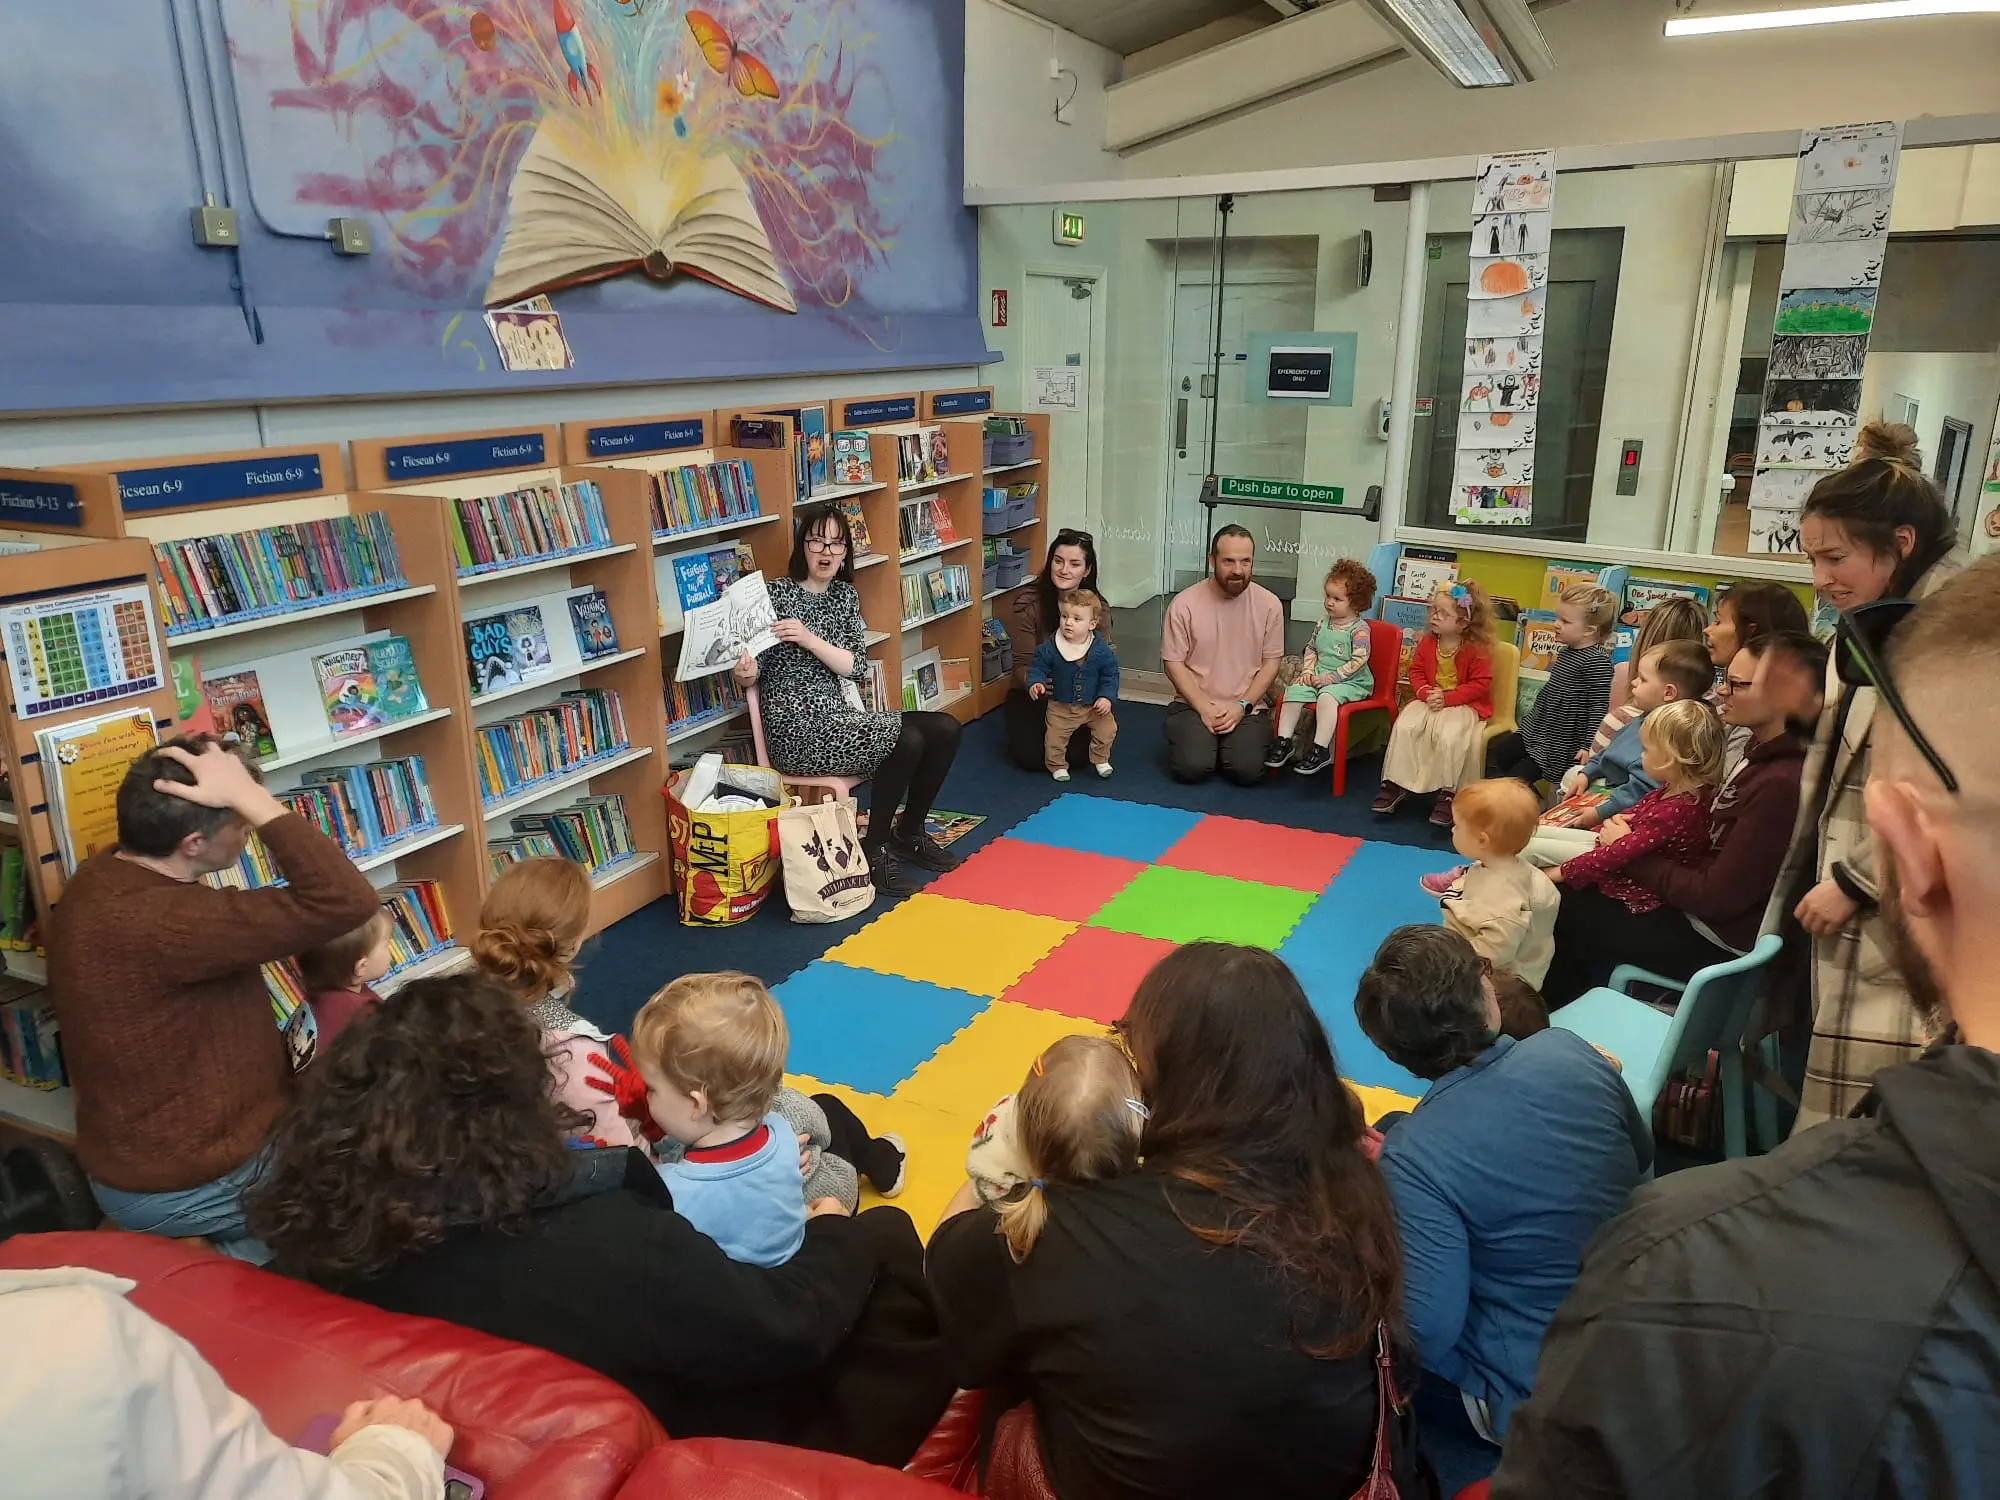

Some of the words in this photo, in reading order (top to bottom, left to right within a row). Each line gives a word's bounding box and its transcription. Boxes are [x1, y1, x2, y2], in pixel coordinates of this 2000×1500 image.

[1277, 368, 1309, 376] EMERGENCY
[600, 436, 623, 448] Ficsean
[623, 434, 635, 445] 6-9
[664, 429, 684, 440] Fiction
[684, 427, 695, 439] 6-9
[492, 444, 519, 458] Fiction
[519, 443, 533, 456] 6-9
[402, 453, 435, 468] Ficsean
[436, 451, 450, 464] 6-9
[246, 470, 283, 486] Fiction
[285, 467, 304, 482] 6-9
[162, 479, 183, 494] 6-9
[1229, 479, 1260, 494] Push
[1262, 483, 1283, 495] bar
[1286, 484, 1299, 496] to
[1302, 488, 1334, 501] open
[0, 492, 36, 509] Fiction
[36, 495, 60, 511] 9-13
[1631, 588, 1646, 598] One
[1647, 589, 1668, 602] Sweet
[473, 622, 506, 644] BAD
[471, 637, 514, 660] GUYS
